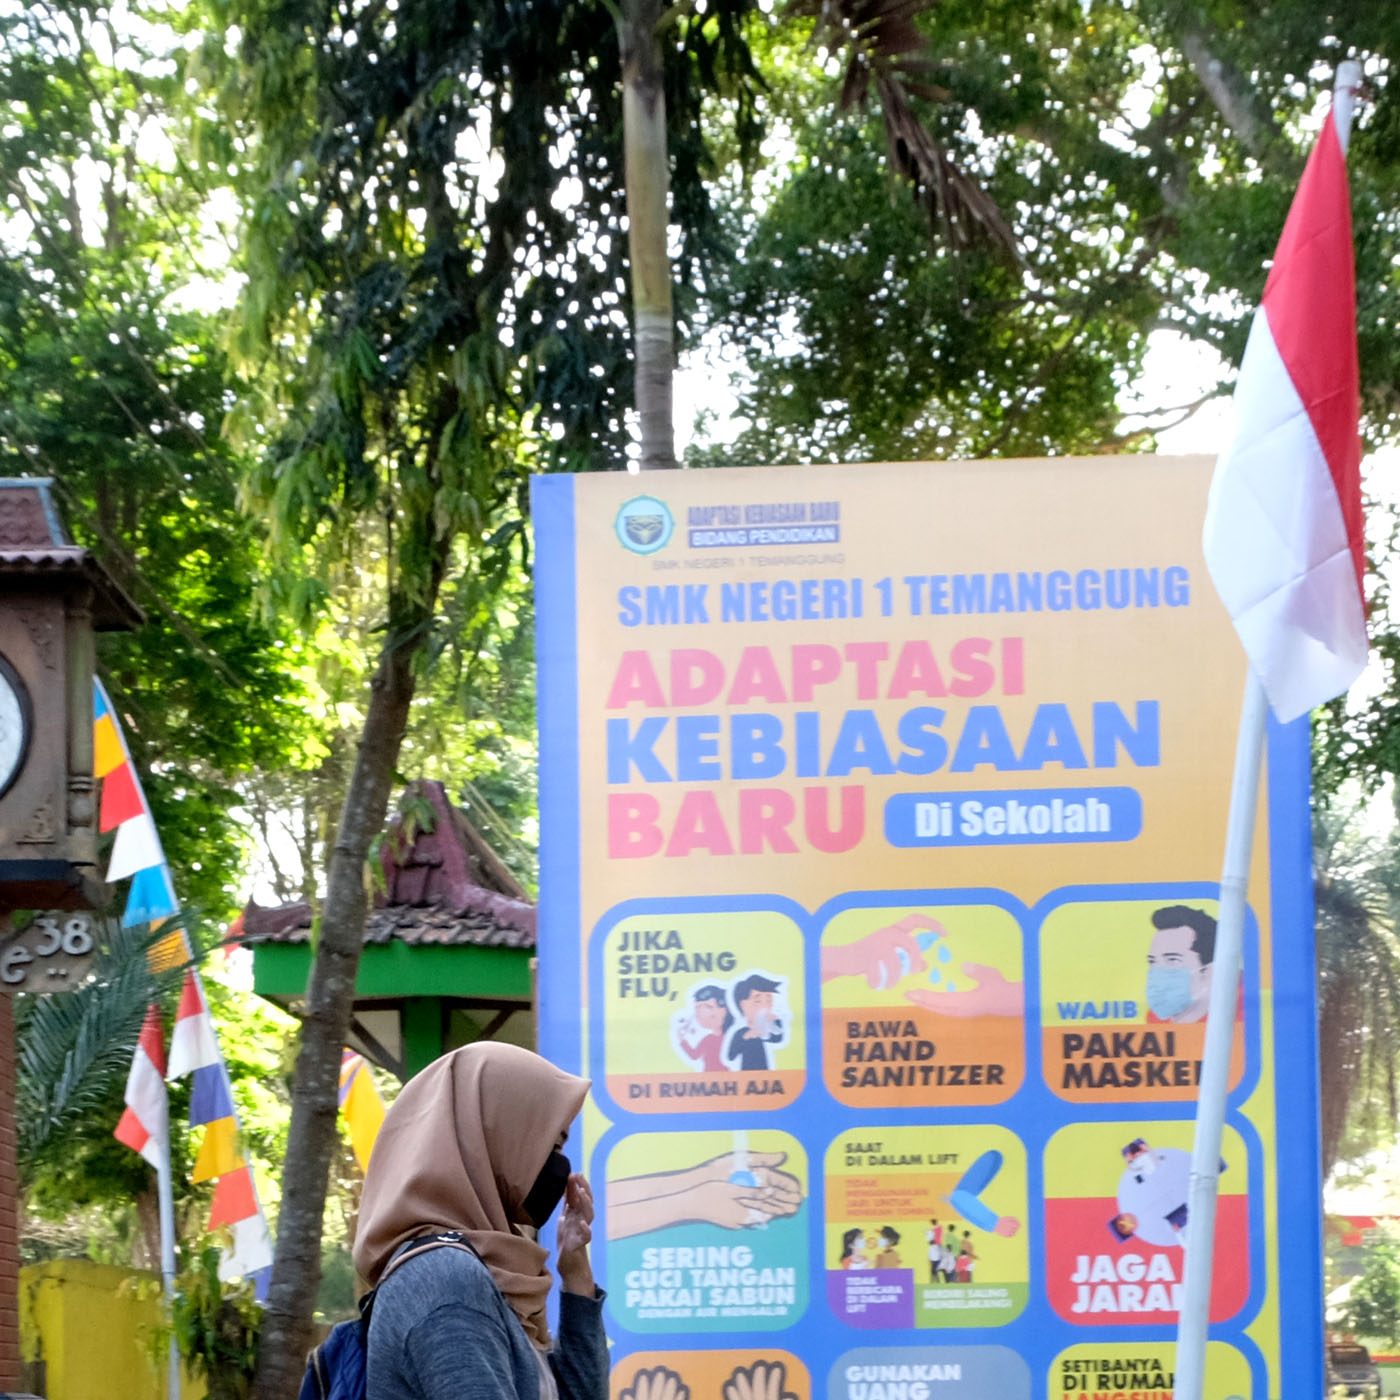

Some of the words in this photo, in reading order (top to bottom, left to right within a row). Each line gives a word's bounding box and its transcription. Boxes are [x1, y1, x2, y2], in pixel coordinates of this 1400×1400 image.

[692, 531, 747, 546] BIDANG
[749, 527, 836, 543] PENDIDIKAN
[618, 584, 710, 627] SMK
[720, 577, 864, 623] NEGERI
[873, 577, 893, 617] 1
[903, 565, 1191, 616] TEMANGGUNG
[605, 637, 1025, 709] ADAPTASI
[606, 700, 1161, 784] KEBIASAAN
[607, 785, 866, 859] BARU
[915, 802, 953, 838] Di
[961, 798, 1111, 837] Sekolah
[37, 917, 93, 957] 38
[618, 930, 683, 951] JIKA
[618, 952, 737, 975] SEDANG
[619, 977, 679, 1002] FLU,
[1057, 1001, 1139, 1020] WAJIB
[847, 1020, 918, 1038] BAWA
[844, 1040, 936, 1063] HAND
[1062, 1031, 1175, 1059] PAKAI
[841, 1064, 1005, 1088] SANITIZER
[628, 1083, 652, 1099] DI
[659, 1081, 738, 1098] RUMAH
[744, 1079, 785, 1096] AJA
[845, 1142, 883, 1154] SAAT
[845, 1156, 862, 1167] DI
[868, 1154, 923, 1166] DALAM
[928, 1153, 958, 1165] LIFT
[641, 1246, 753, 1269] SERING
[1070, 1254, 1177, 1283] JAGA
[625, 1270, 683, 1288] CUCI
[690, 1268, 795, 1286] TANGAN
[626, 1289, 701, 1307] PAKAI
[709, 1287, 795, 1305] SABUN
[845, 1364, 962, 1382] GUNAKAN
[1062, 1359, 1162, 1372] SETIBANYA
[1063, 1375, 1087, 1390] DI
